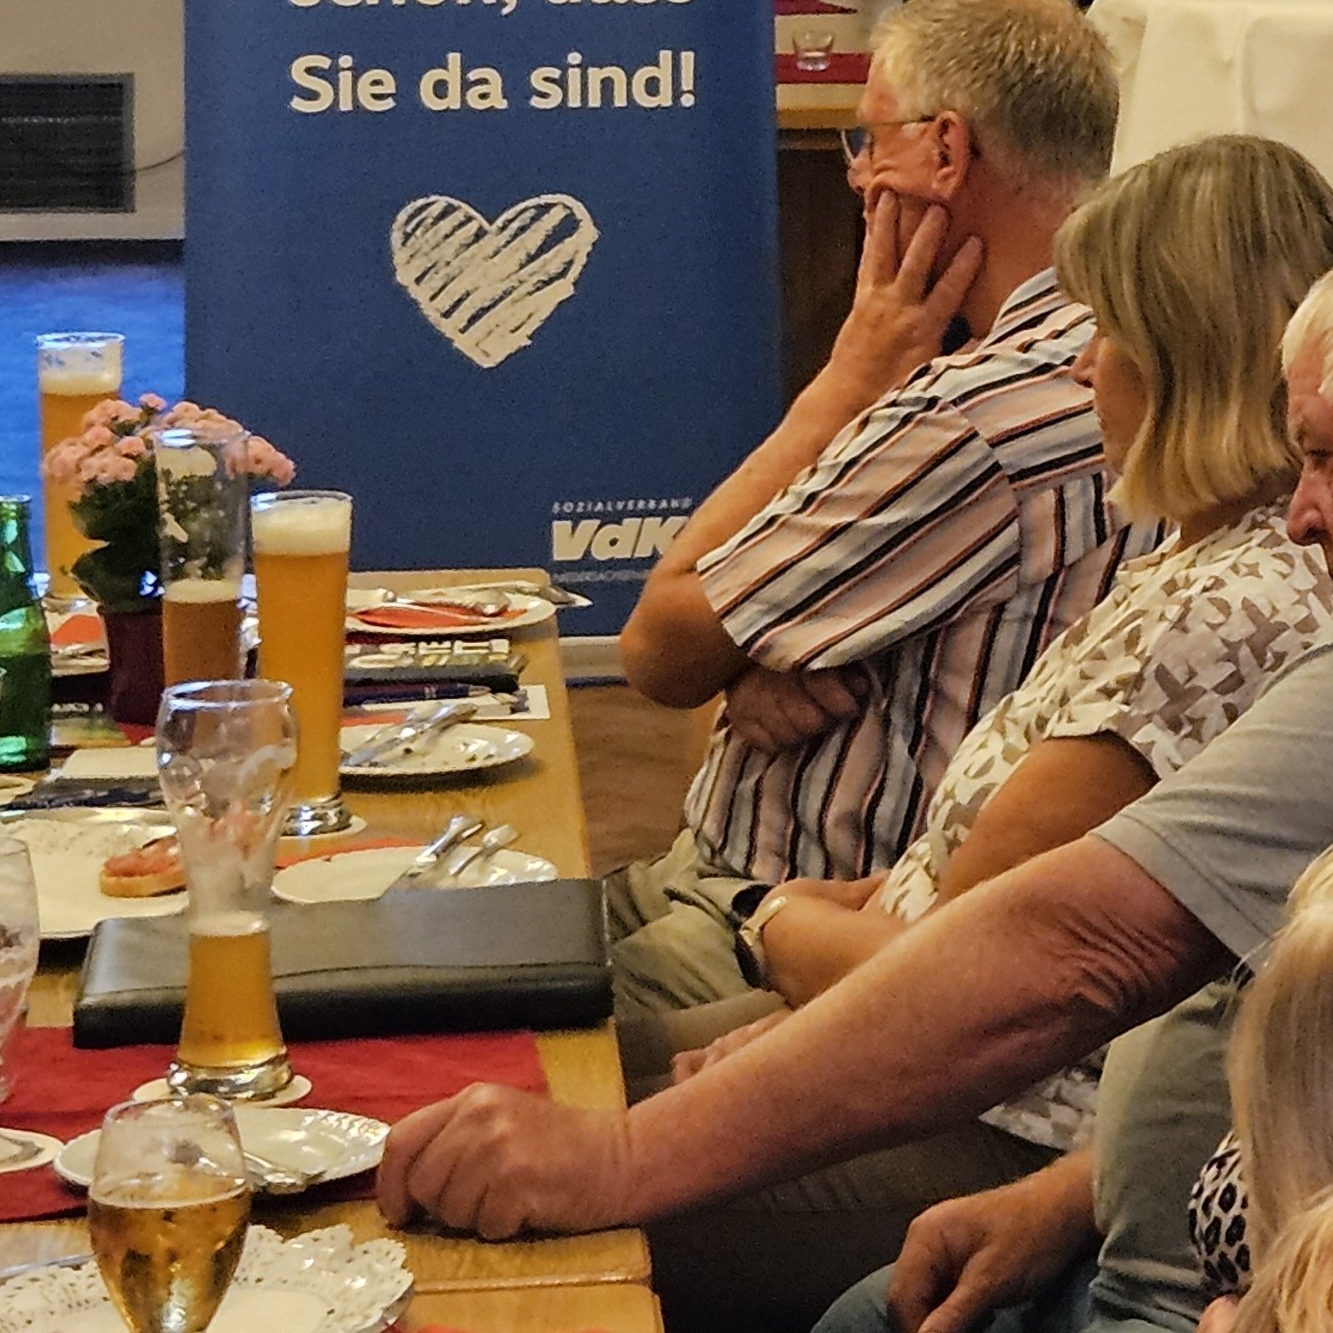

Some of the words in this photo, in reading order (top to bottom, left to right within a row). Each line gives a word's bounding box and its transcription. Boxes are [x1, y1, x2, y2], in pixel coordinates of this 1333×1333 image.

[290, 54, 398, 113] Sie
[419, 52, 508, 111] da
[530, 50, 696, 108] sind!
[552, 516, 690, 561] VdK
